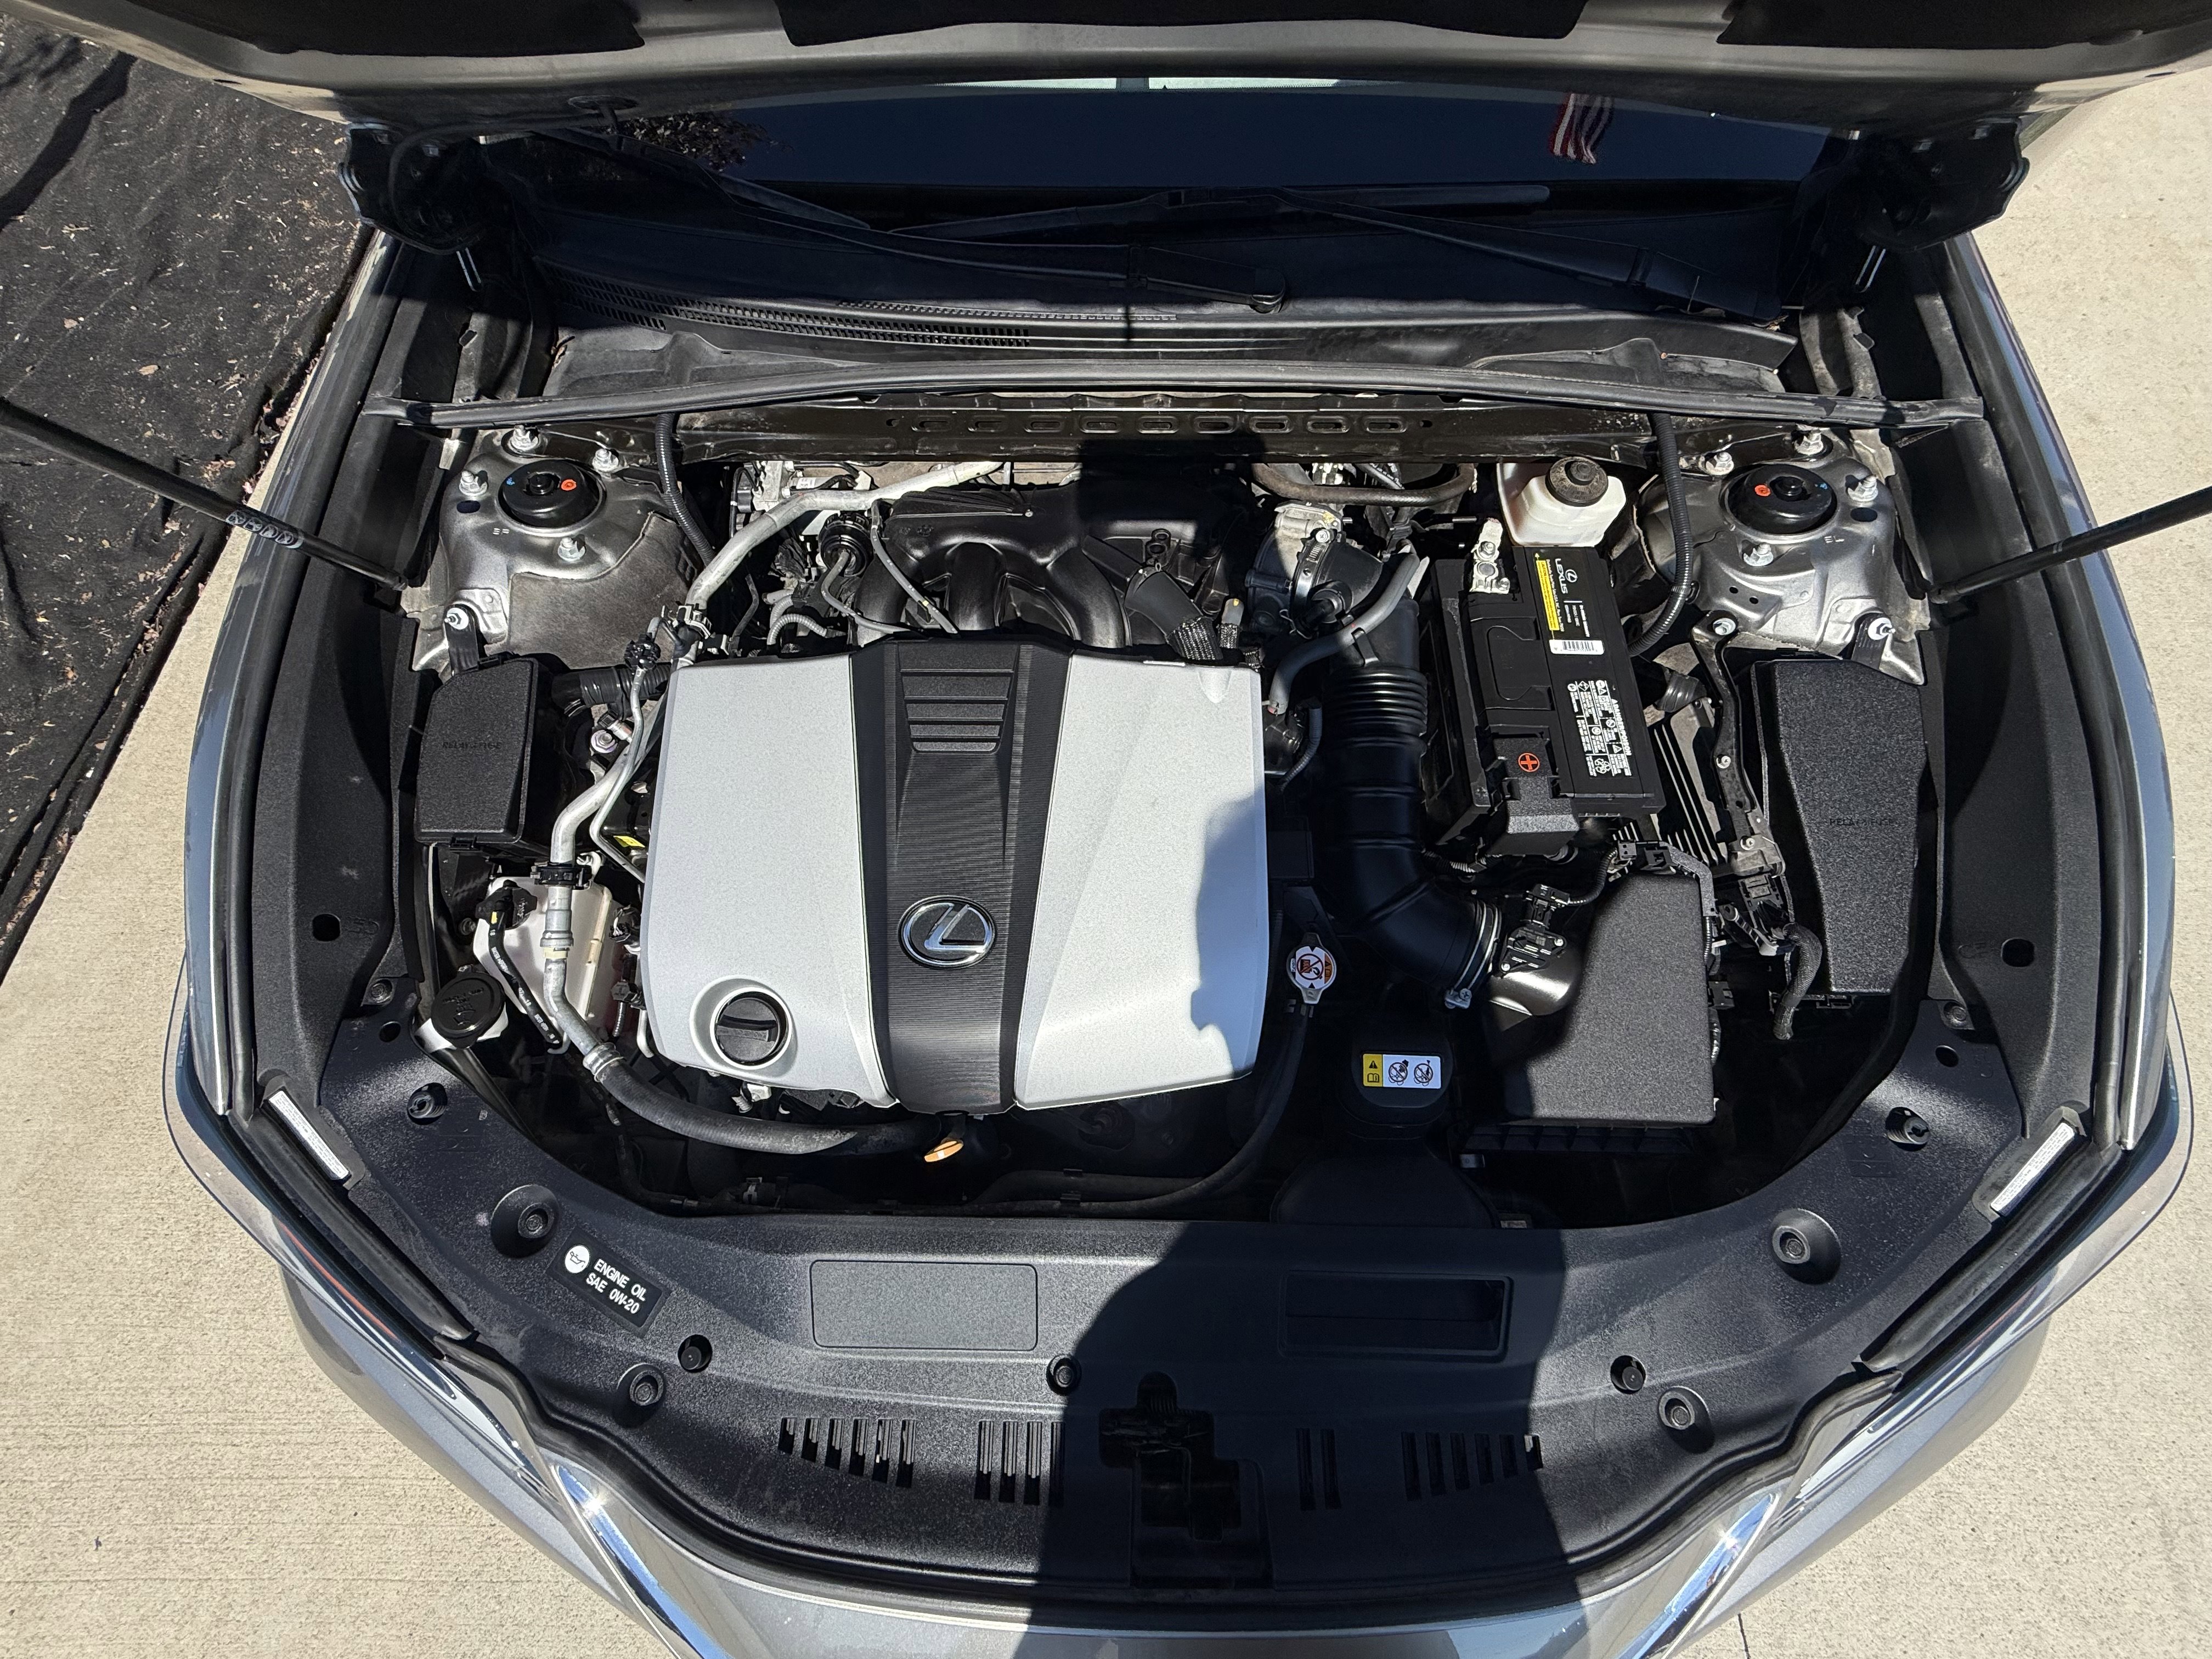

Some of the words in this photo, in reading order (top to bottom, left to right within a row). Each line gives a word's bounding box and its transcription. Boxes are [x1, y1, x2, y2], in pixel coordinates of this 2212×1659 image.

[1555, 558, 1568, 594] LEXUS
[1613, 704, 1632, 755] DANGER/POISON
[586, 1273, 608, 1293] SAE
[609, 1289, 640, 1314] 0W-20
[594, 1259, 629, 1289] ENGINE
[631, 1284, 646, 1301] OIL
